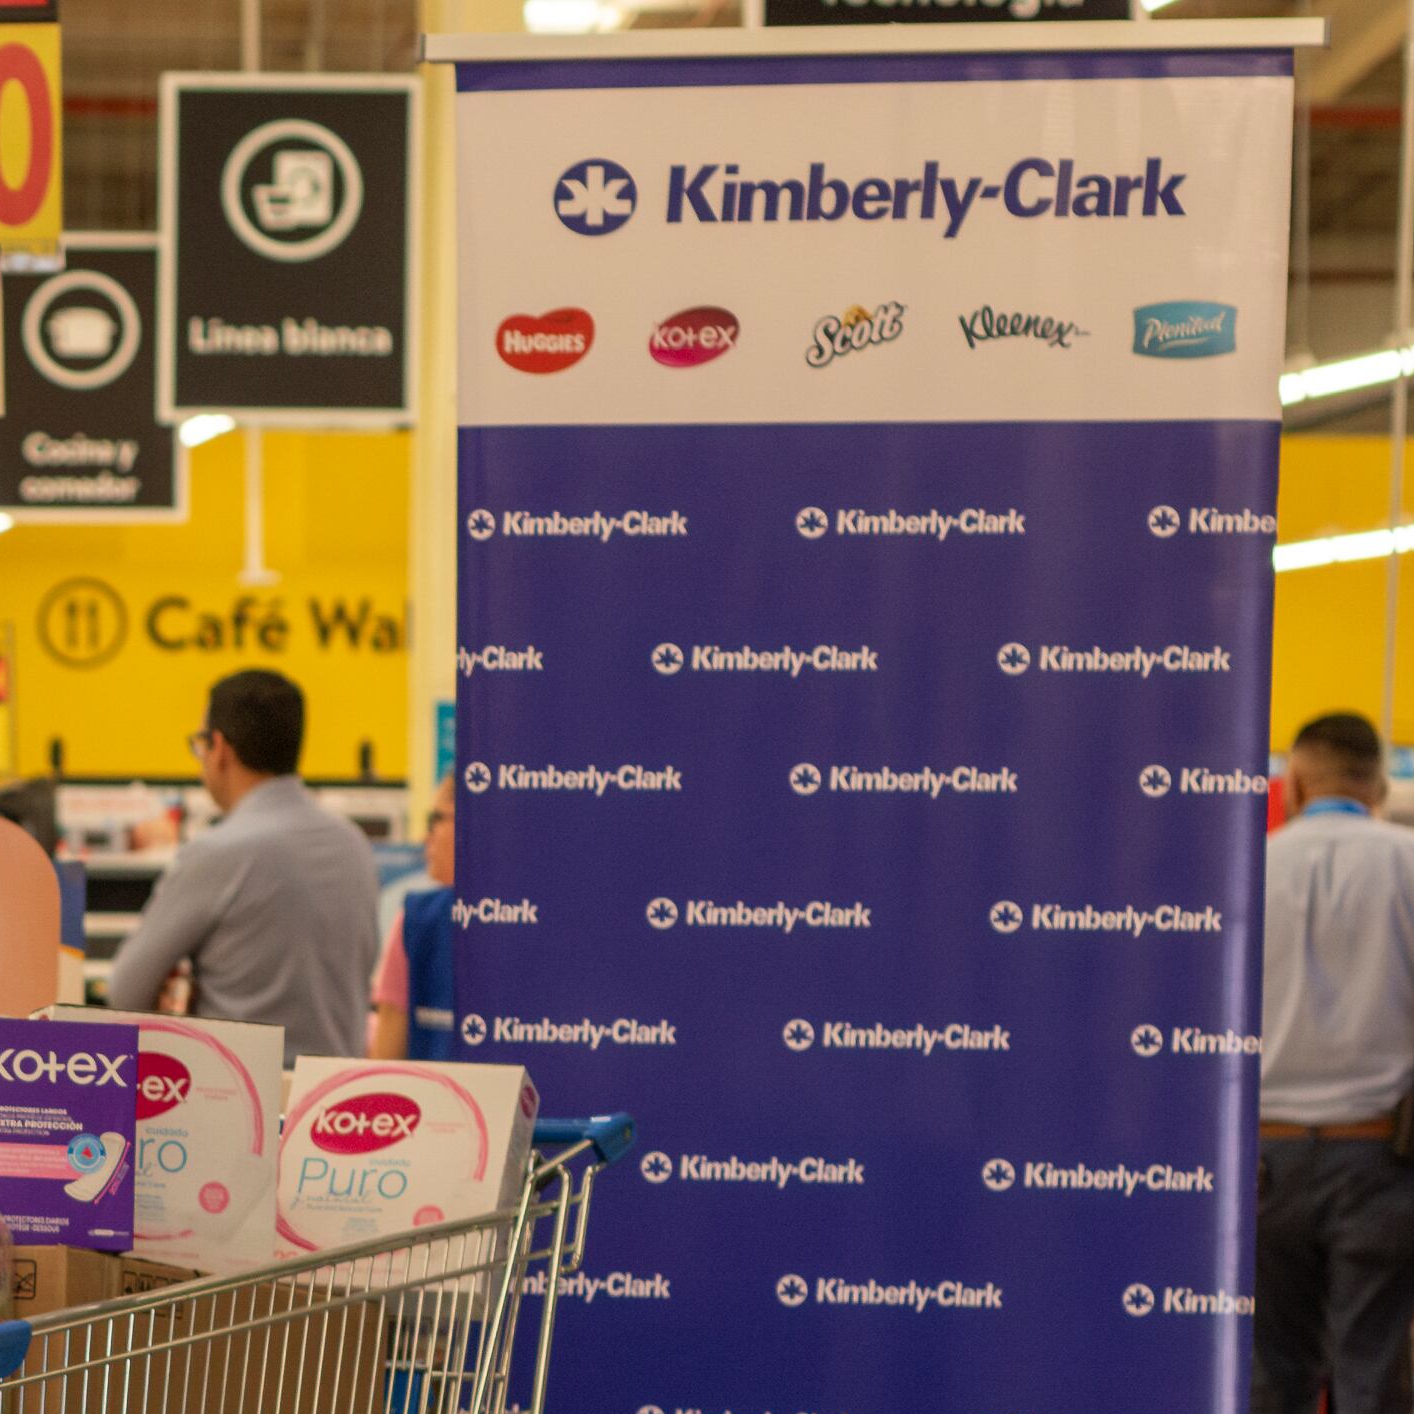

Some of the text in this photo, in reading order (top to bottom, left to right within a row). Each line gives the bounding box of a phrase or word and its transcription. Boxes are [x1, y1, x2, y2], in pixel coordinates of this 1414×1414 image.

[667, 157, 1186, 239] Kimberly-Clark
[282, 316, 393, 356] blanca
[503, 329, 586, 355] HUGGIES
[804, 300, 905, 369] Scott
[958, 305, 1076, 350] Kleenex
[503, 510, 686, 541] Kimberly-Clark
[837, 508, 1025, 540] Kimberly-Clark
[145, 594, 290, 653] Café
[692, 645, 878, 676] Kimberly-Clark
[1039, 645, 1230, 678] Kimberly-Clark
[499, 764, 681, 795] Kimberly-Clark
[687, 900, 869, 932] Kimberly-Clark
[1033, 904, 1220, 936] Kimberly-Clark
[495, 1017, 675, 1049] Kimberly-Clark
[24, 1119, 83, 1132] PROTECCIÓN
[298, 1157, 408, 1200] Puro
[681, 1155, 862, 1187] Kimberly-Clark
[1025, 1162, 1212, 1195] Kimberly-Clark
[817, 1279, 1001, 1311] Kimberly-Clark
